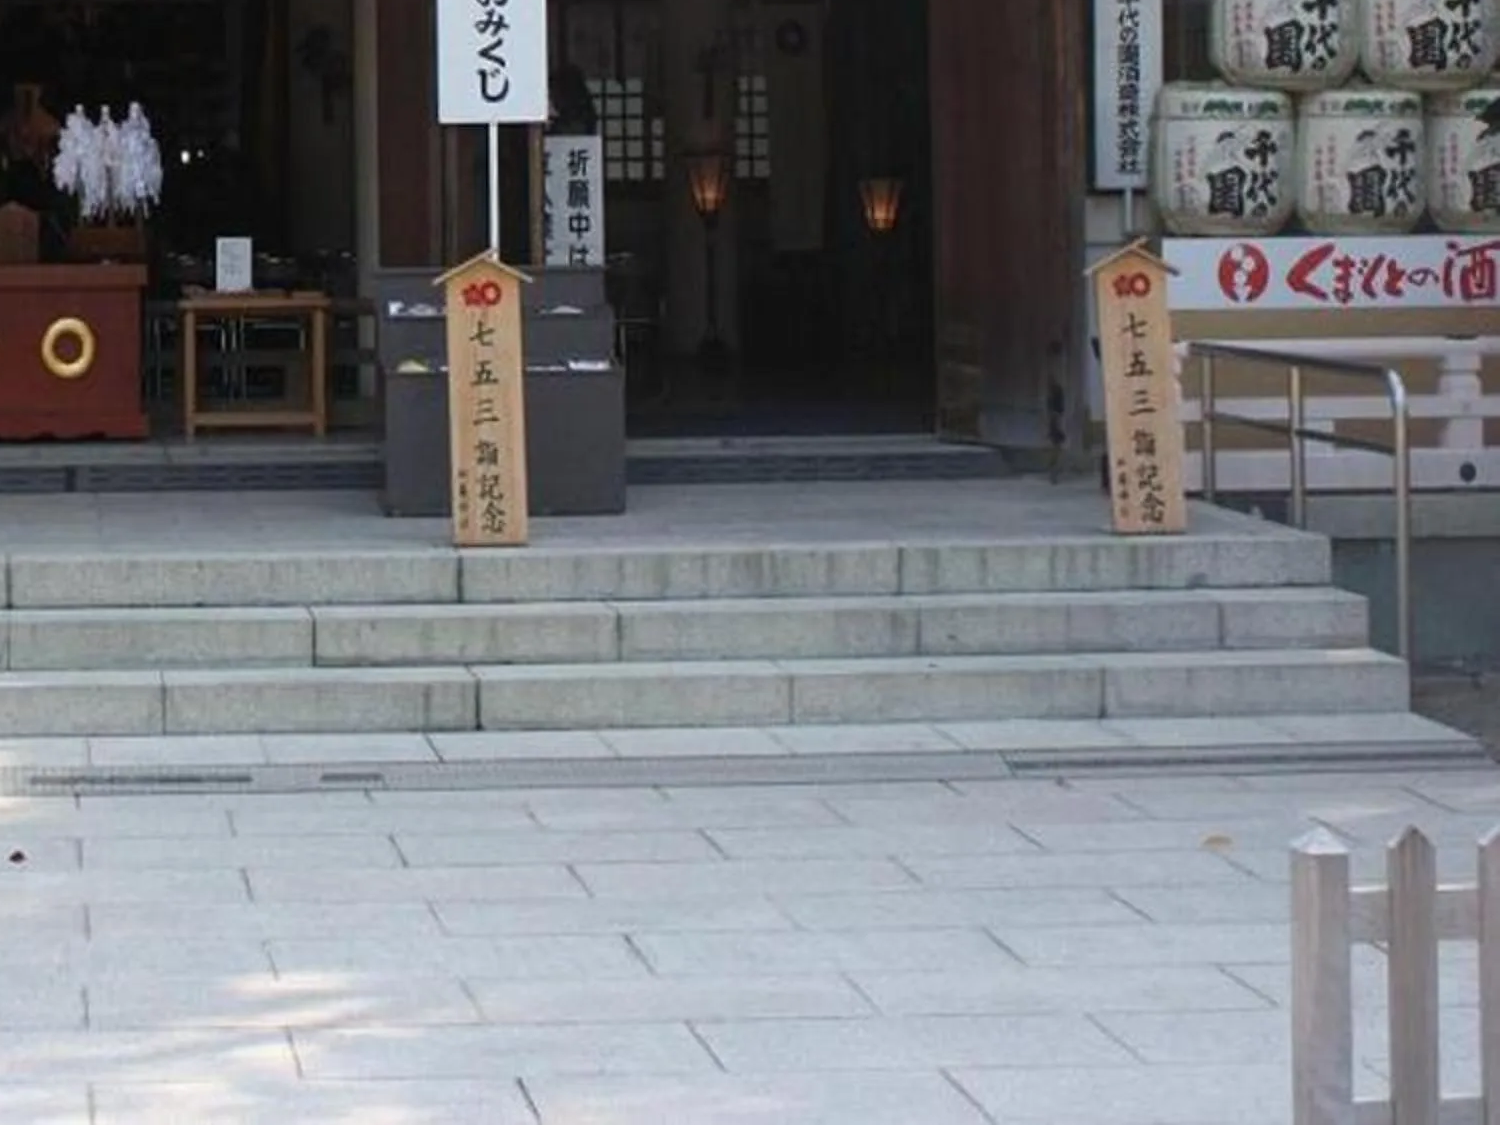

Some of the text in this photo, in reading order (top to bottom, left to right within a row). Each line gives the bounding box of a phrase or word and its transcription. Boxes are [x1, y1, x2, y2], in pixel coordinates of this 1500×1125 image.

[469, 321, 506, 534] 七五三詣記念
[1120, 311, 1164, 523] 七五三詣記念
